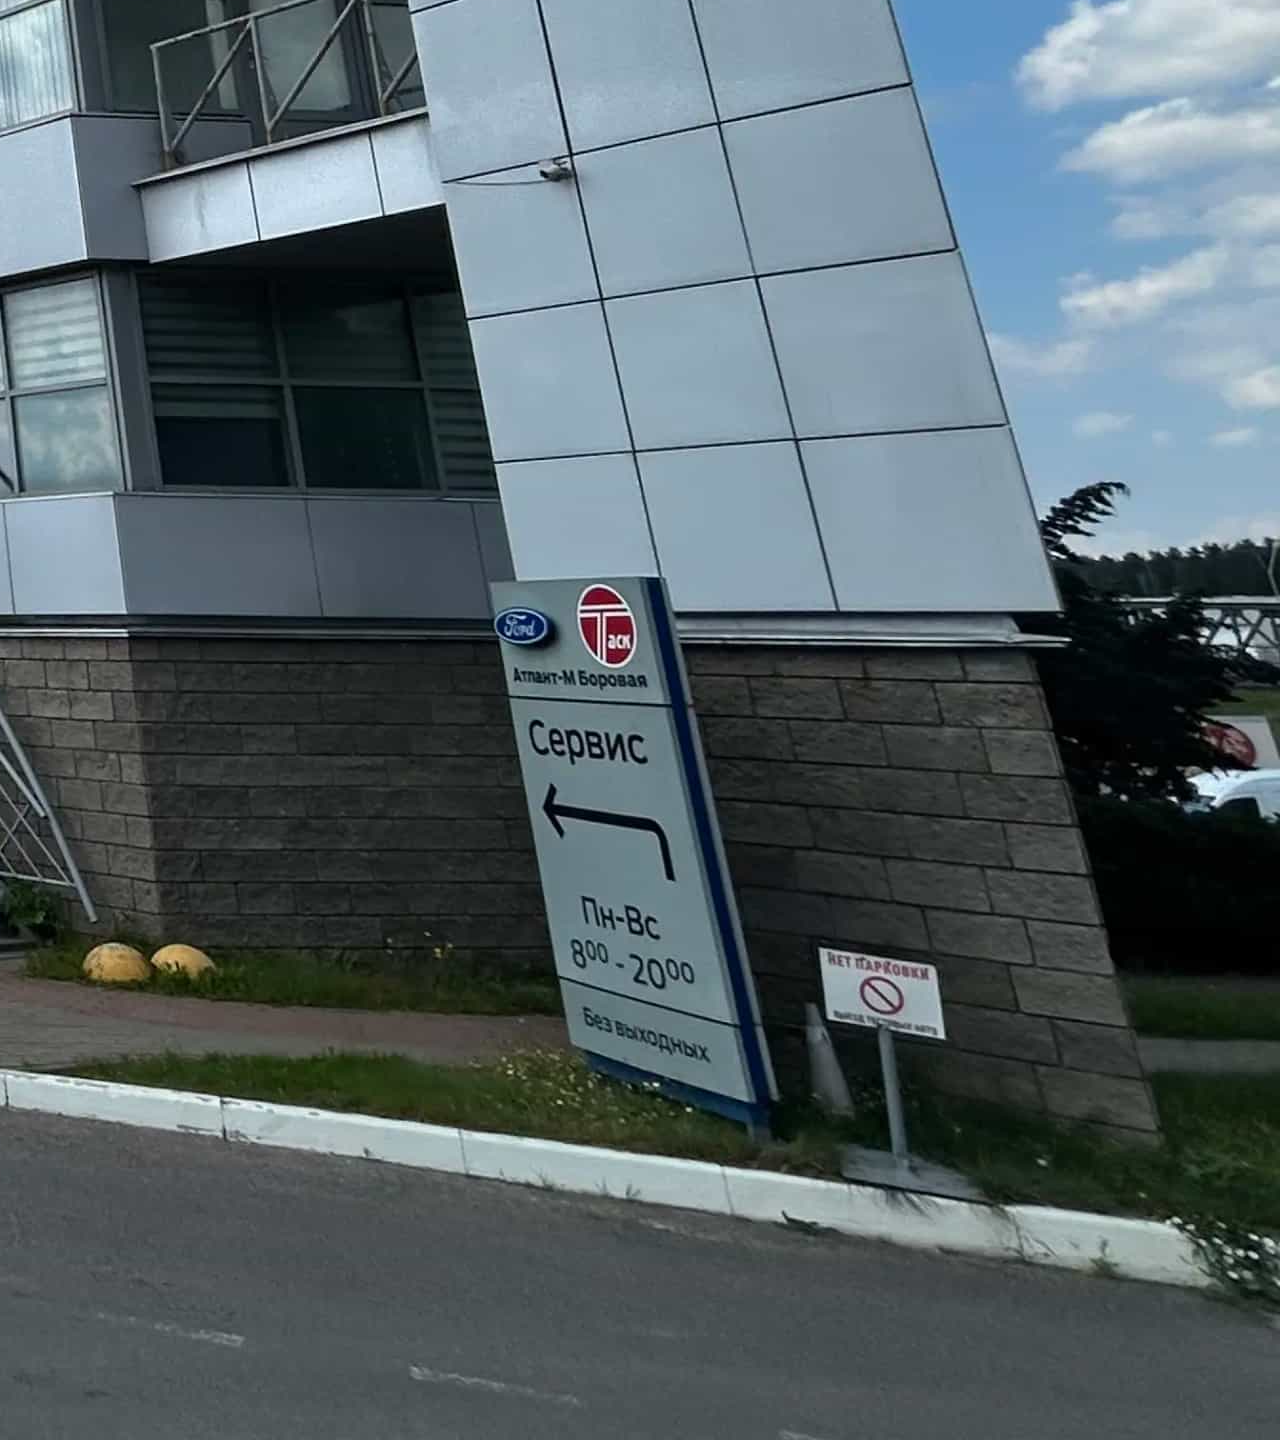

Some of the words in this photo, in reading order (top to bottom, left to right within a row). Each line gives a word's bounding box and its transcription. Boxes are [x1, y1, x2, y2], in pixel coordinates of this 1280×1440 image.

[503, 613, 537, 637] Ford
[579, 669, 649, 691] Боровая
[528, 718, 649, 768] Сервис
[580, 895, 661, 941] Пн-Вс
[827, 951, 852, 969] НЕТ
[855, 957, 930, 981] ПАРКОВКИ
[582, 1006, 613, 1034] Без
[615, 1020, 711, 1063] выходных
